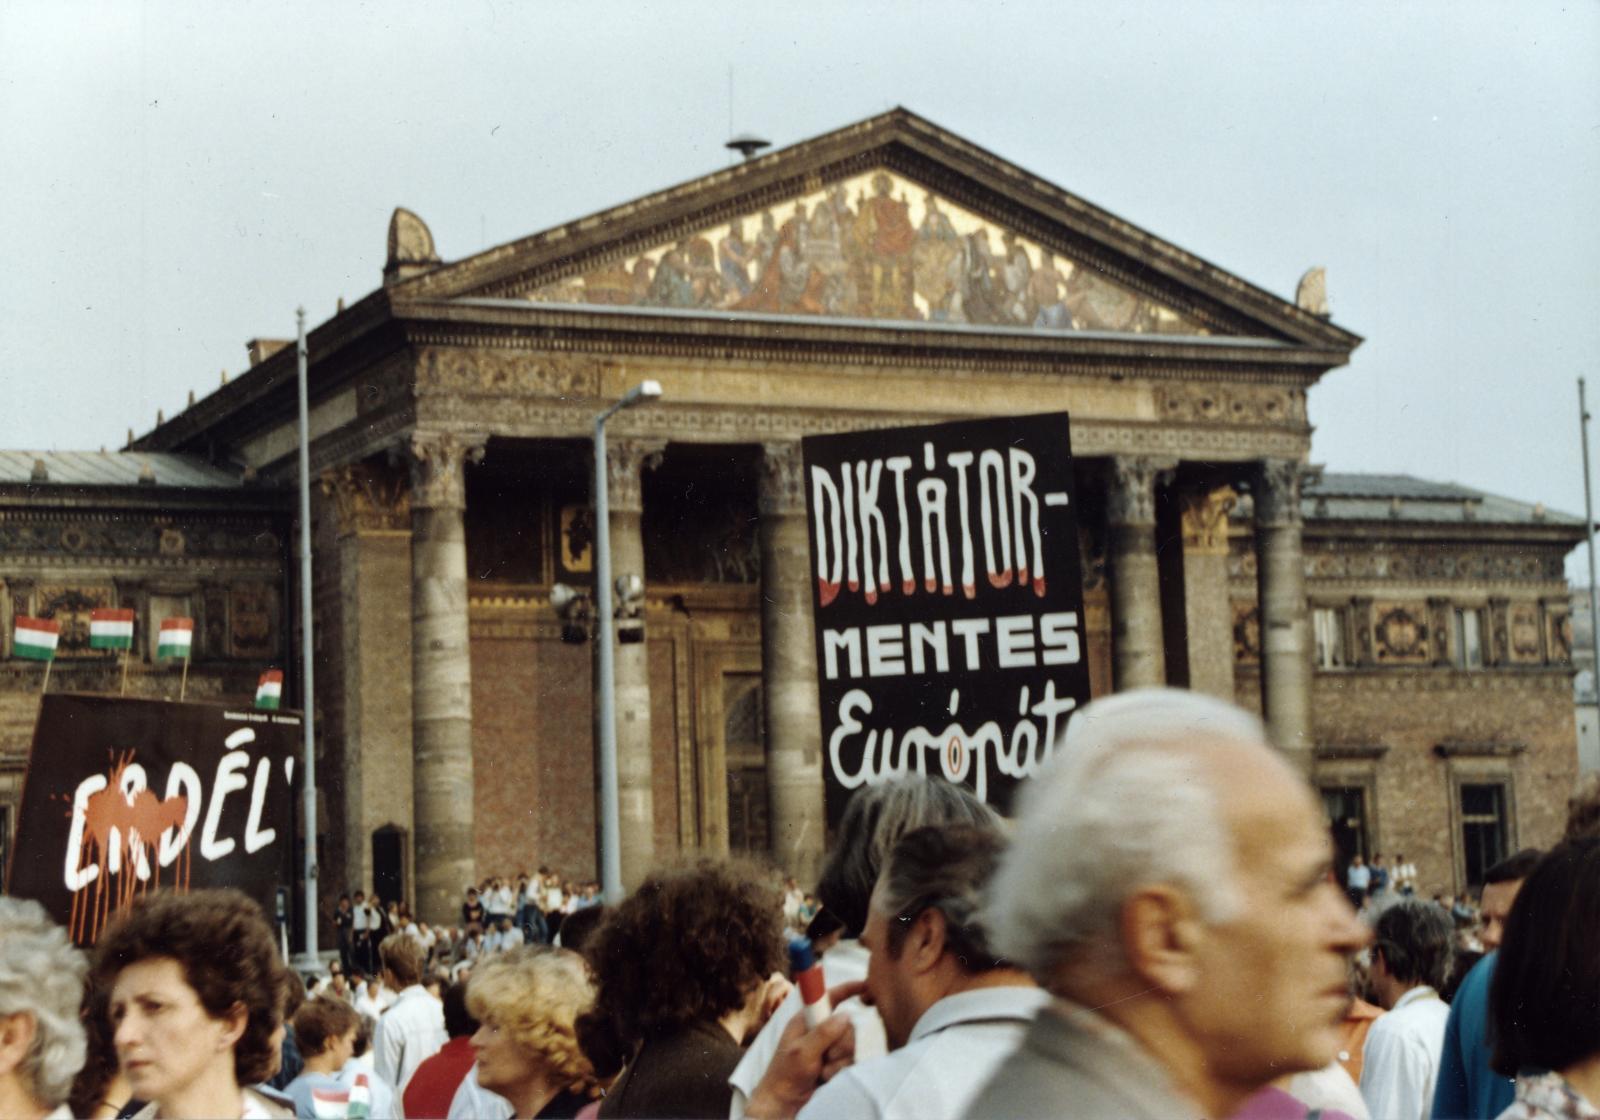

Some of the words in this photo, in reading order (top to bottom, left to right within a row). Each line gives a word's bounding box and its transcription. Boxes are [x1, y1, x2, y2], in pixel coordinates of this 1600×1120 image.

[811, 441, 1068, 607] DIKTÁTOR-
[823, 611, 1080, 679] MENTES
[64, 727, 294, 892] ERDÉL
